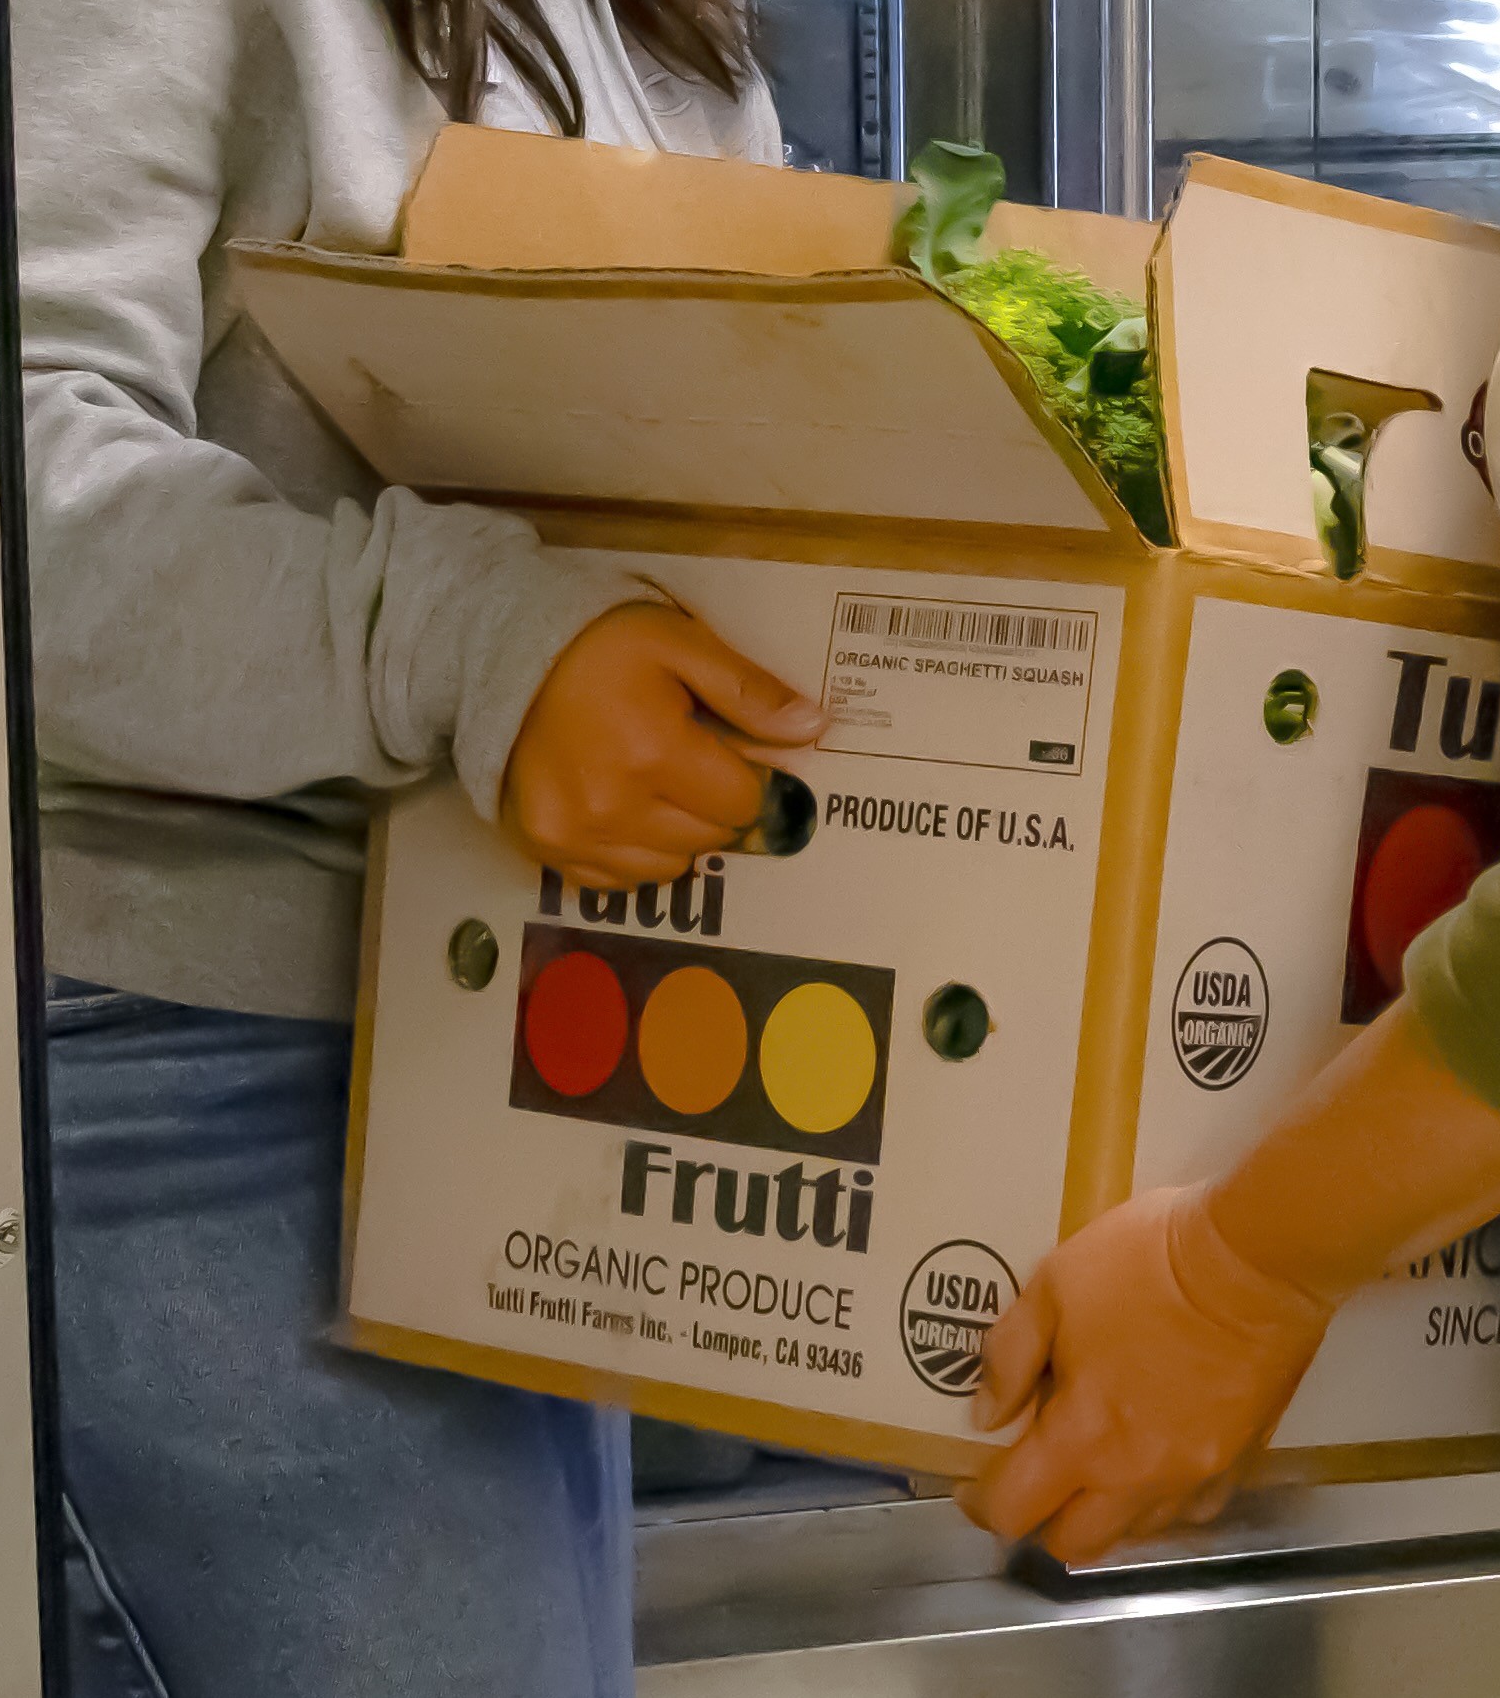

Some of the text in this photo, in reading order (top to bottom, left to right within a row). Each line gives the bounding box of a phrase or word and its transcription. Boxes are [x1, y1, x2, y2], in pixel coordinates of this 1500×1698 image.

[834, 651, 1084, 687] ORGANIC SPAGHETTI SQUASH
[825, 793, 1075, 852] PRODUCE OF U.S.A.
[1193, 970, 1252, 1008] USDA
[1183, 1018, 1254, 1048] ORGANIC
[621, 1139, 874, 1255] Frutti
[505, 1229, 855, 1331] ORGANIC PRODUCE
[927, 1270, 1000, 1316] USDA
[486, 1282, 525, 1314] Tutti
[530, 1290, 576, 1327] Frutti
[581, 1301, 634, 1335] Farms
[692, 1319, 768, 1366] Lompoc,
[775, 1336, 800, 1368] CA
[805, 1343, 864, 1379] 93436
[914, 1318, 984, 1355] ORGAN
